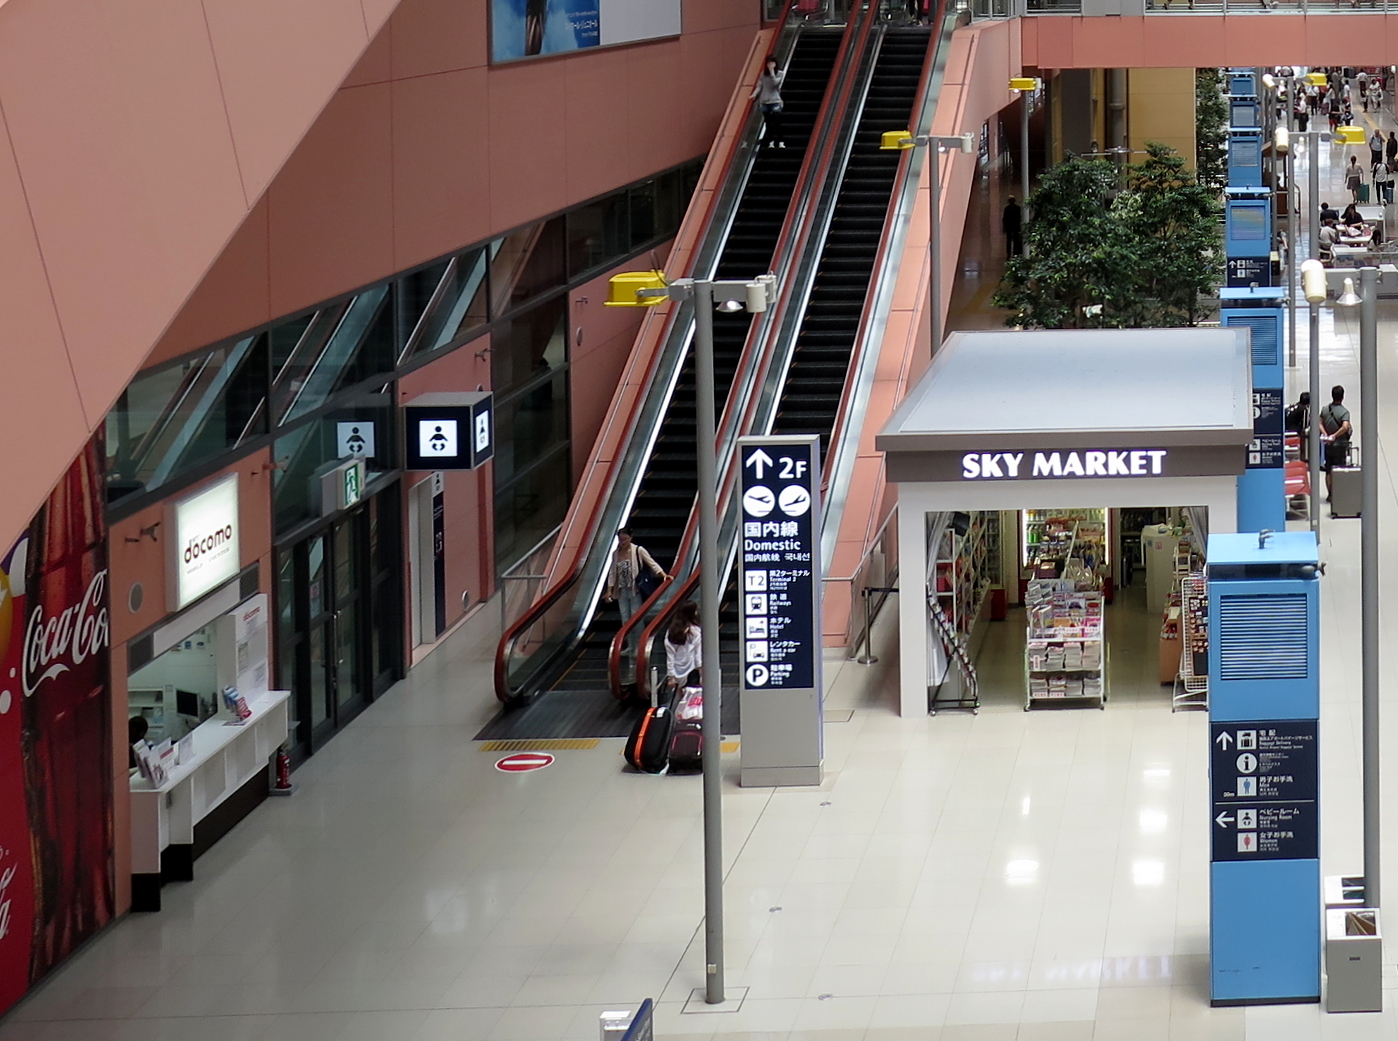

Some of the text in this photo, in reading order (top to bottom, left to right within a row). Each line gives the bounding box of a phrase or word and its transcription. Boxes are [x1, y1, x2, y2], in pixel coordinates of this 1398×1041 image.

[779, 457, 807, 479] 2F
[962, 450, 1168, 478] SKY MARKET
[744, 521, 799, 538] 国内線
[184, 524, 233, 564] docomo
[744, 539, 801, 552] Domestic
[769, 640, 801, 648] レンタカー
[1260, 807, 1300, 815] ベビールーム
